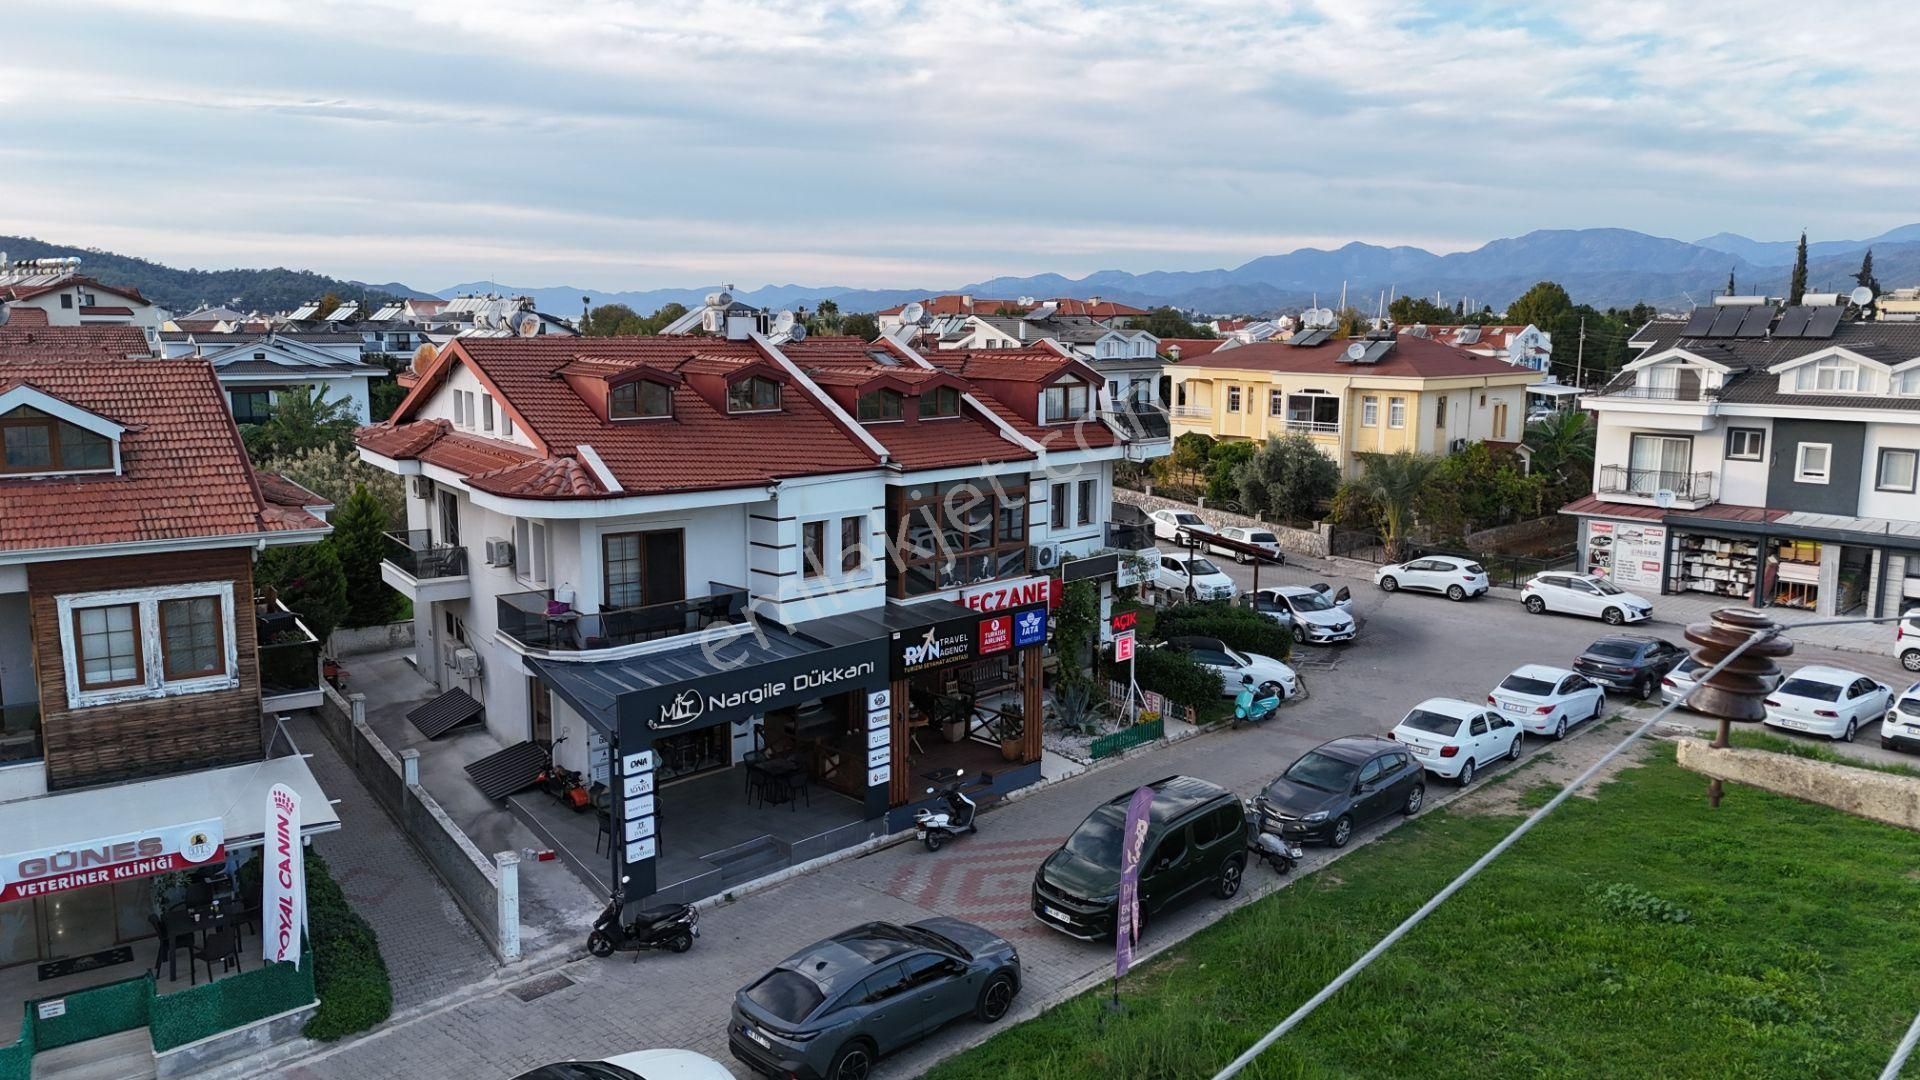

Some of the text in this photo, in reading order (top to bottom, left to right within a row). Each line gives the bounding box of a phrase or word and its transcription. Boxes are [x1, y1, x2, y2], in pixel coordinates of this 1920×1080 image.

[969, 581, 1048, 613] ECZANE
[1113, 611, 1137, 631] AÇIK
[984, 628, 1006, 639] TURKISH
[1021, 625, 1039, 636] IATA
[940, 633, 969, 647] TRAVEL
[984, 635, 1007, 645] AIRLINES
[940, 643, 969, 657] AGENCY
[708, 682, 787, 712] Nargile
[793, 661, 875, 692] Dükkanı
[277, 814, 293, 890] CANIN
[16, 855, 173, 897] VETERİNER KLİNİĞİ
